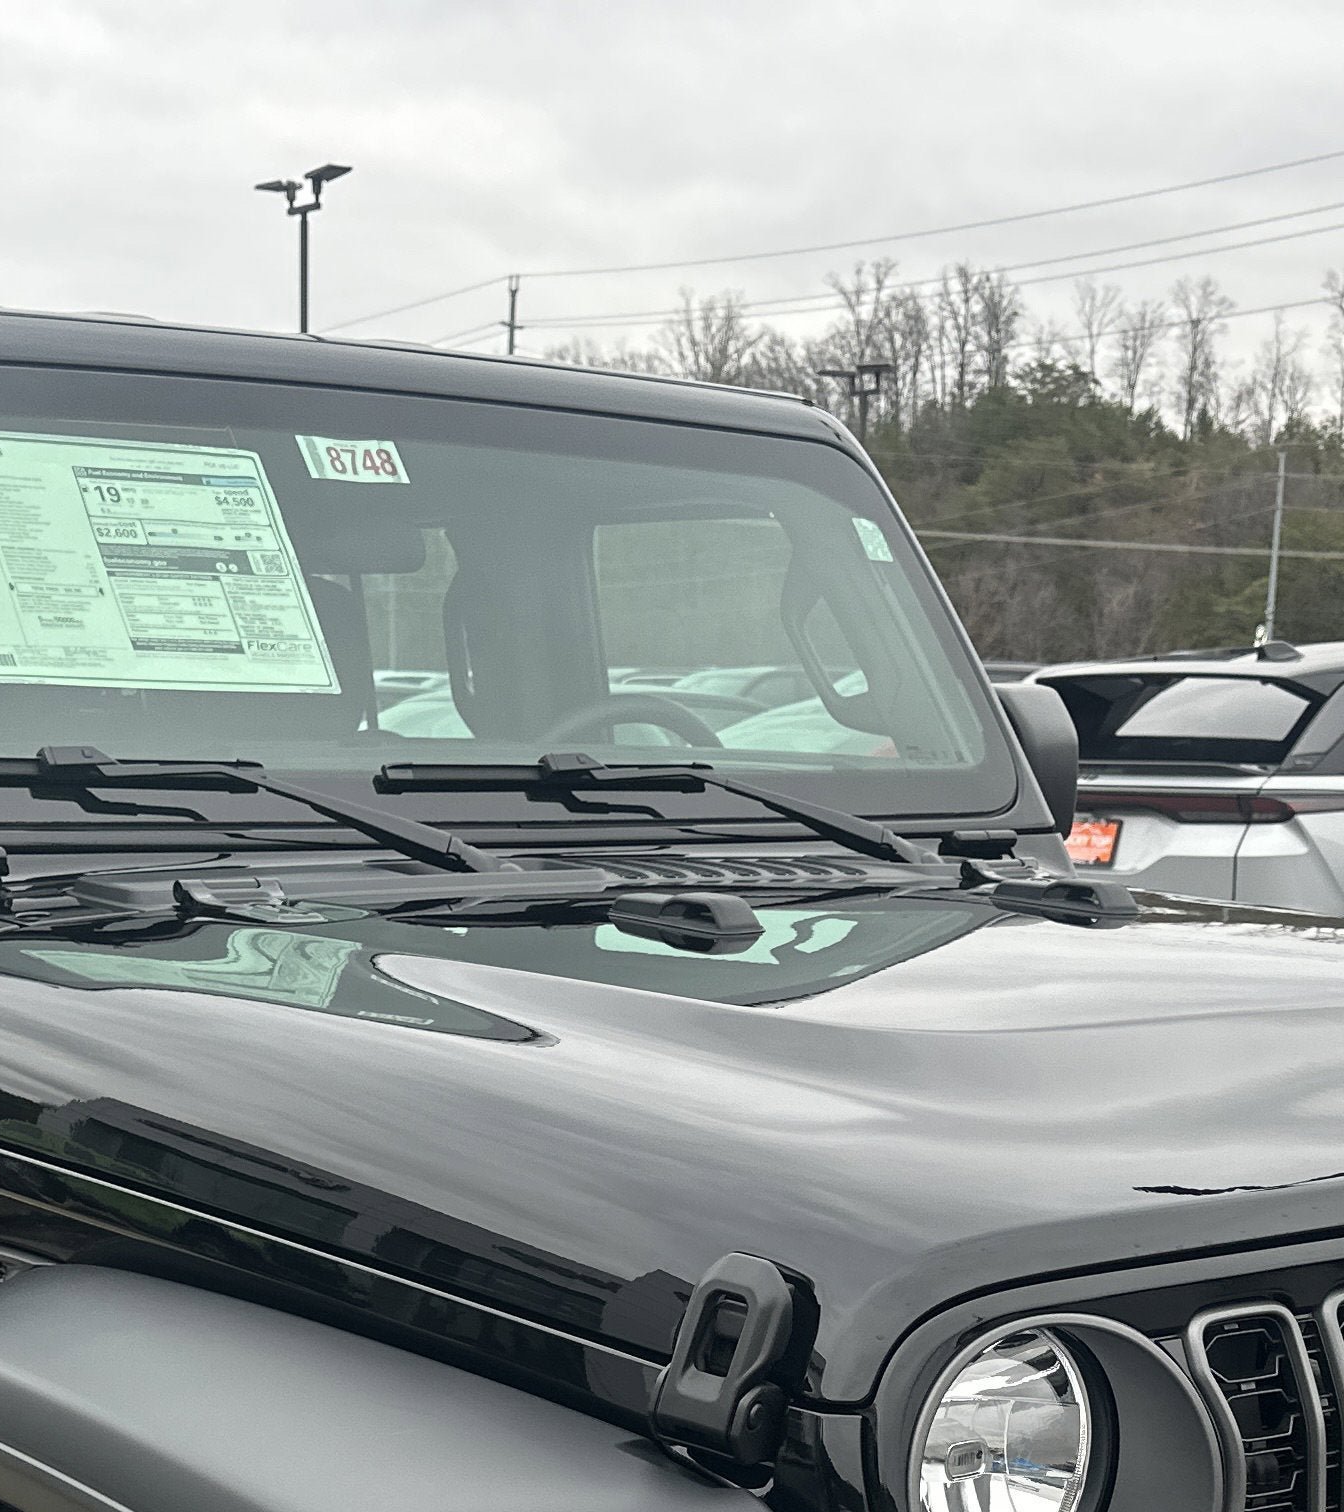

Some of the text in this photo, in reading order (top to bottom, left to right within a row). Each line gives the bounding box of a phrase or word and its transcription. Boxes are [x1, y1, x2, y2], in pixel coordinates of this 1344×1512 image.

[325, 446, 399, 477] 8748
[93, 485, 121, 503] 19
[96, 527, 138, 539] $2,600
[247, 639, 312, 653] FlexCare
